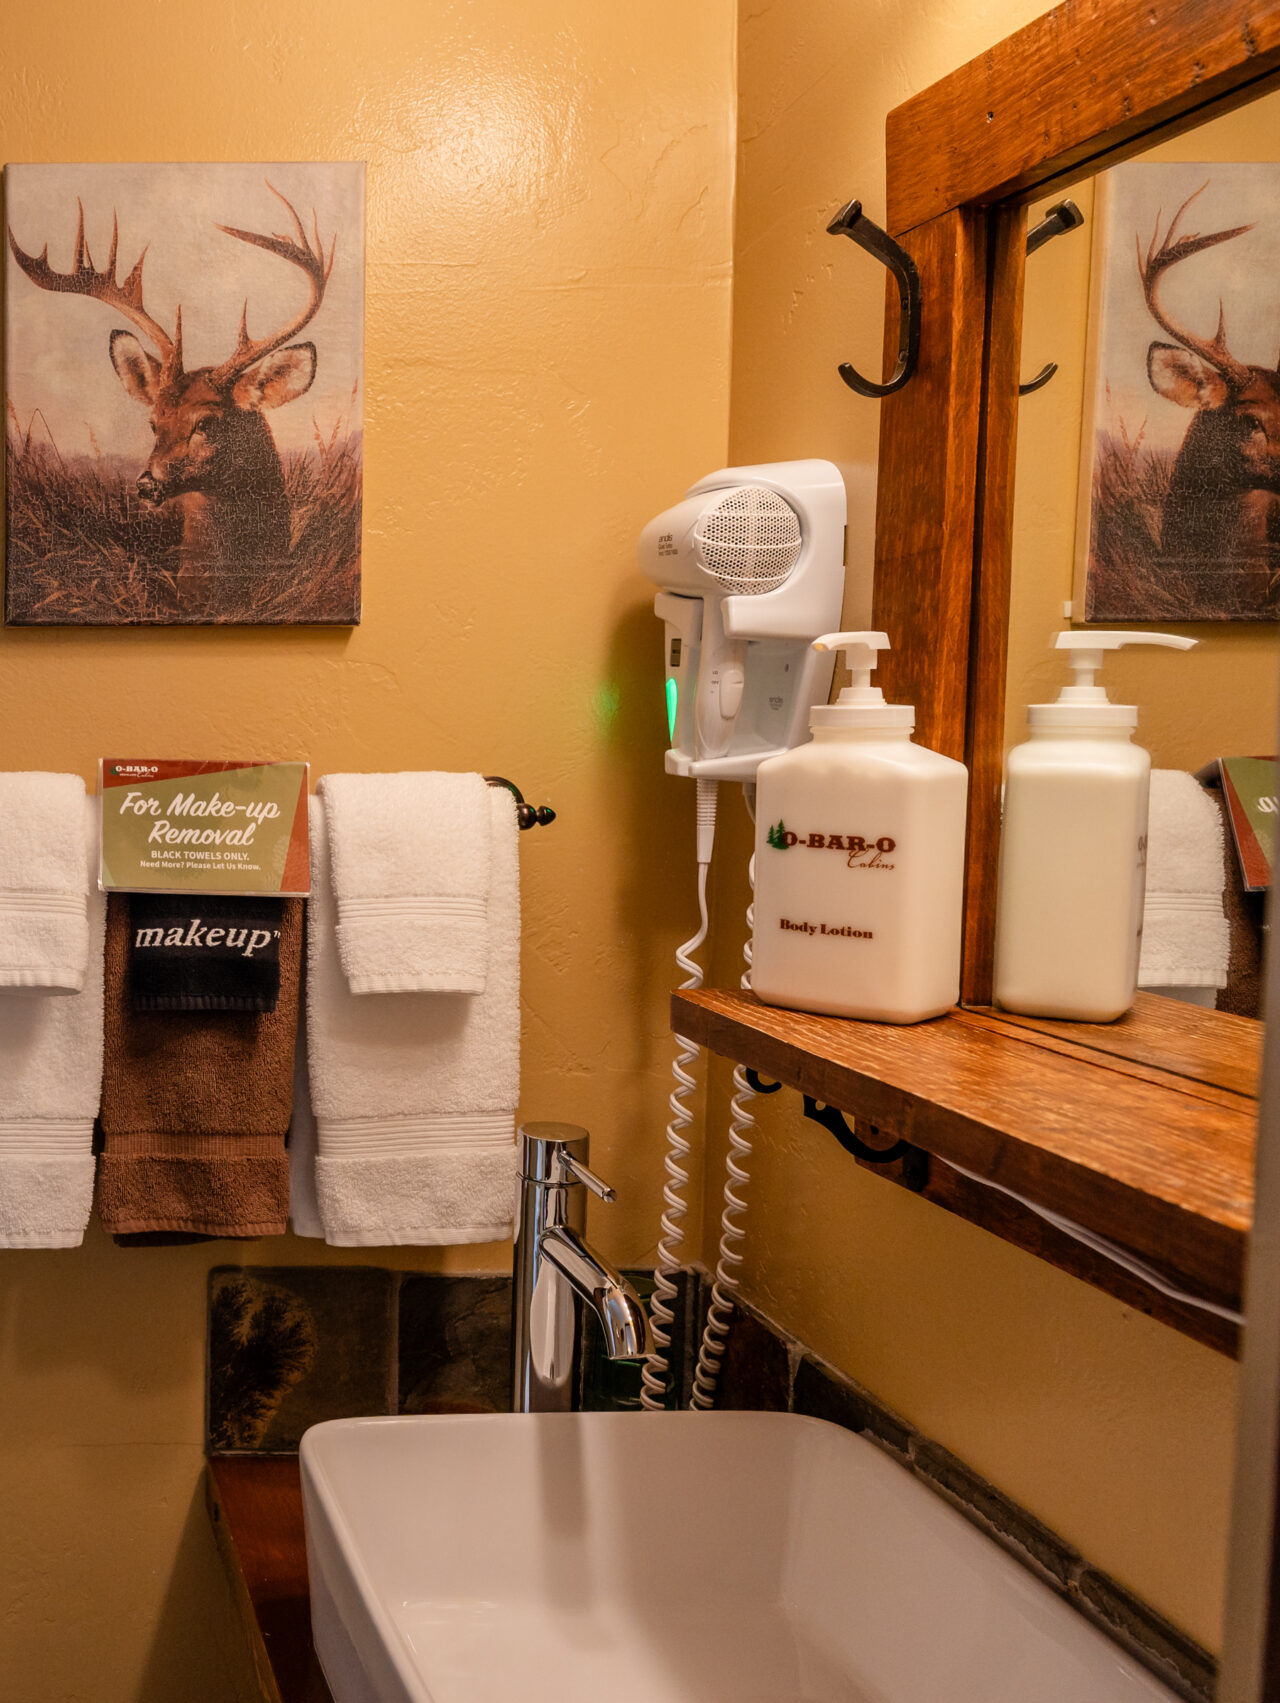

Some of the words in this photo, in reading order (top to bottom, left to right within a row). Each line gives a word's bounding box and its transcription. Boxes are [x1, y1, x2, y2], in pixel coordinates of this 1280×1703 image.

[120, 791, 162, 816] For
[166, 792, 281, 824] Make-up
[148, 820, 255, 846] Removal
[781, 831, 896, 853] O-BAR-O
[140, 861, 160, 869] Need
[161, 861, 185, 869] More?
[186, 861, 211, 870] Please
[212, 862, 225, 870] Let
[226, 862, 237, 870] Us
[237, 863, 261, 871] Know.
[151, 850, 181, 859] BLACK
[183, 851, 223, 860] TOWELS
[223, 852, 250, 861] ONLY.
[847, 848, 895, 871] Cabins
[779, 918, 817, 936] Body
[819, 923, 873, 939] Lotion
